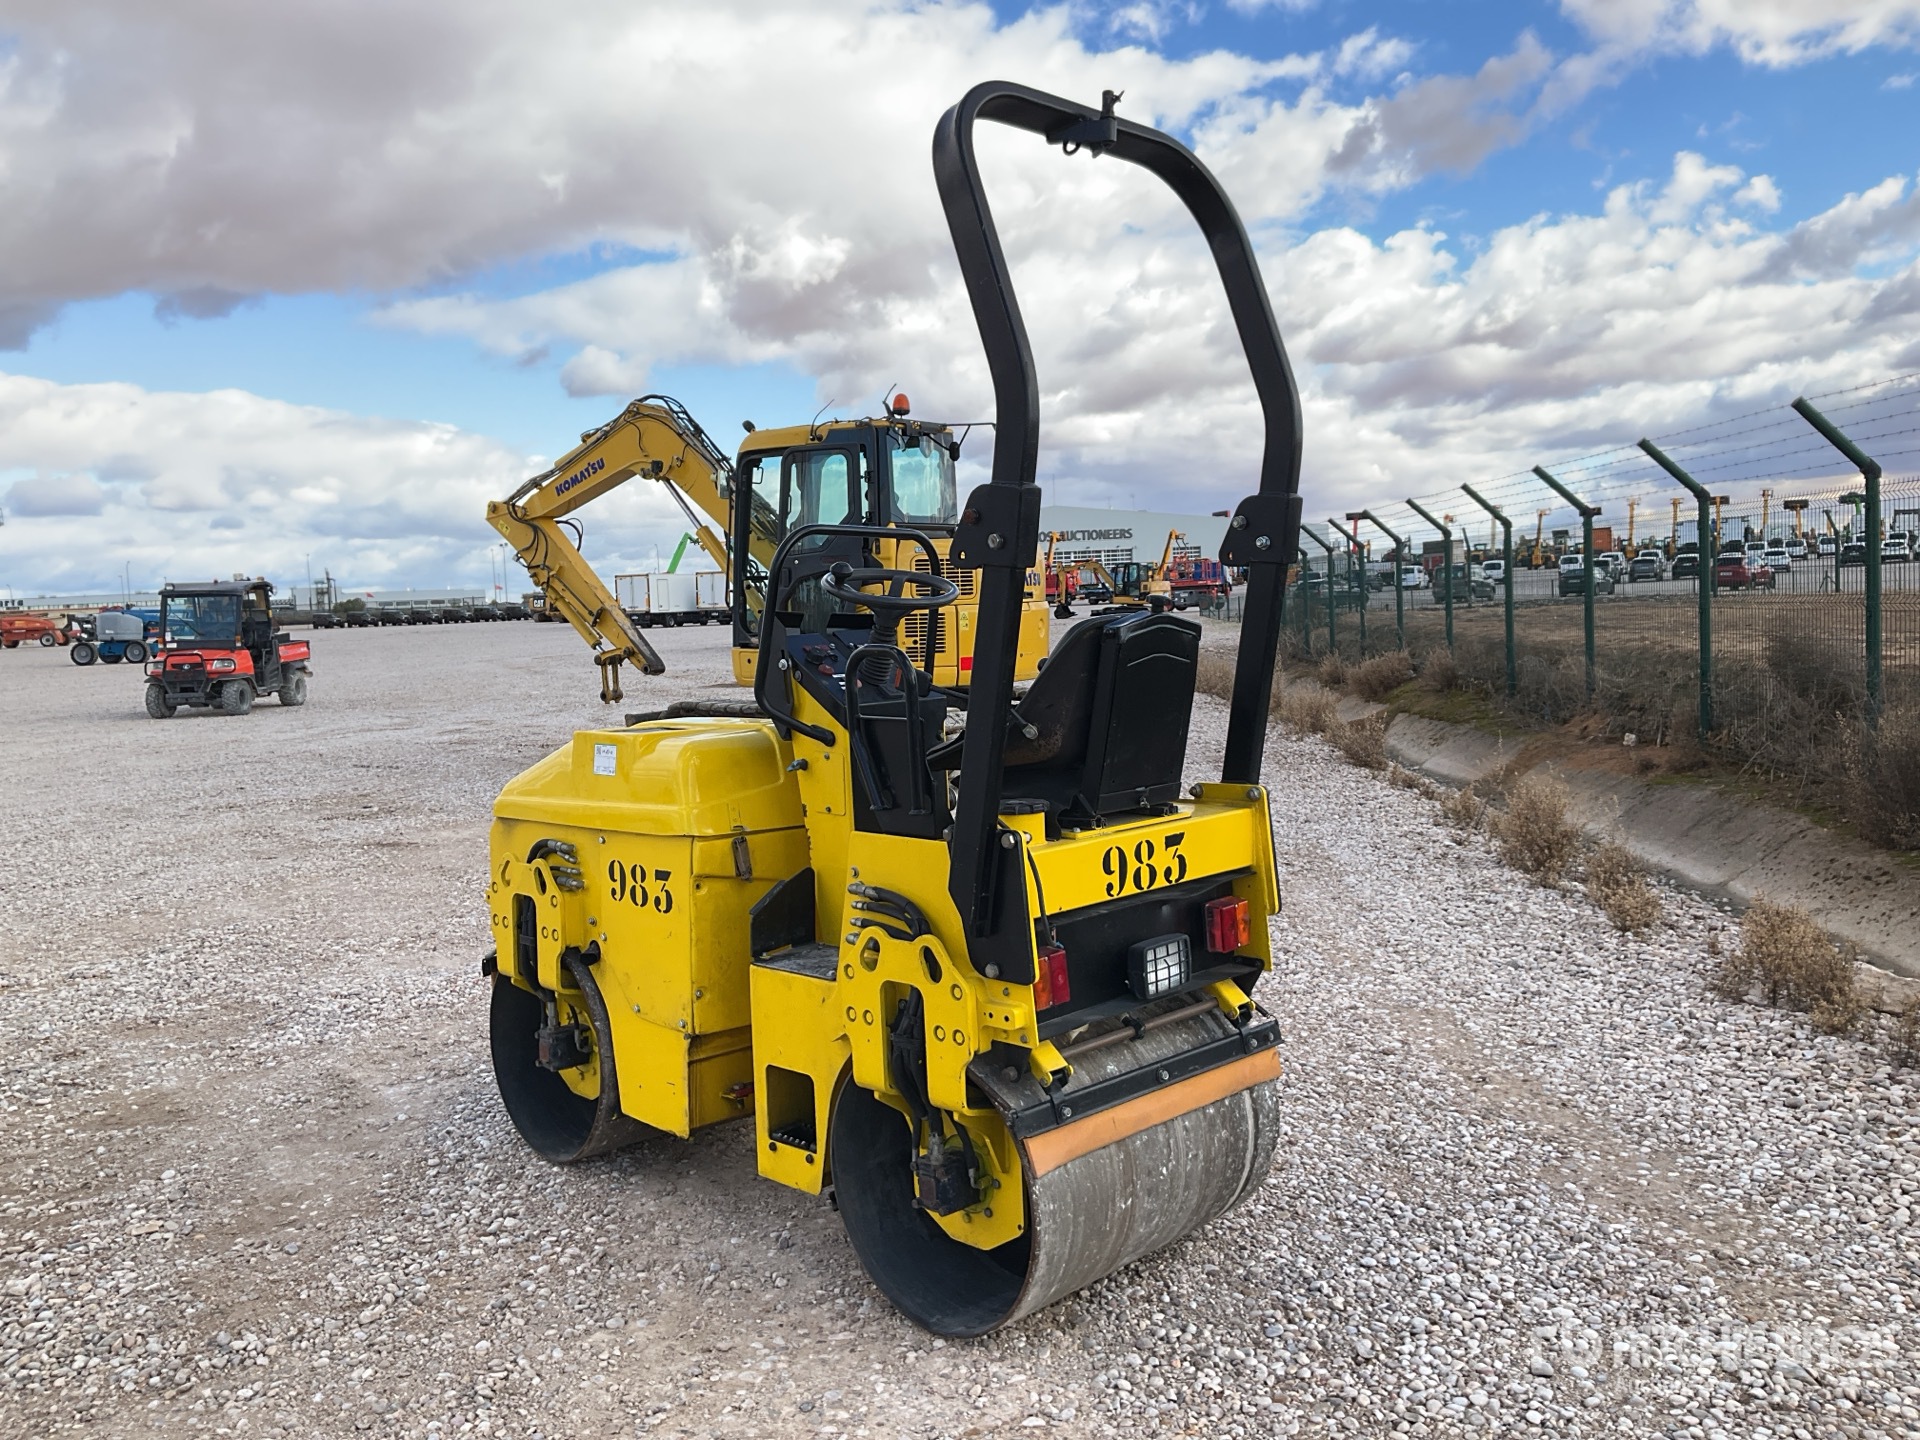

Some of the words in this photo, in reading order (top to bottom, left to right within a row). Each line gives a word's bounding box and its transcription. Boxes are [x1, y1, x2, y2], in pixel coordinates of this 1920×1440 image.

[555, 457, 605, 497] KOMATSU
[533, 599, 544, 608] CAT
[608, 859, 673, 914] 983
[1102, 831, 1188, 898] 983
